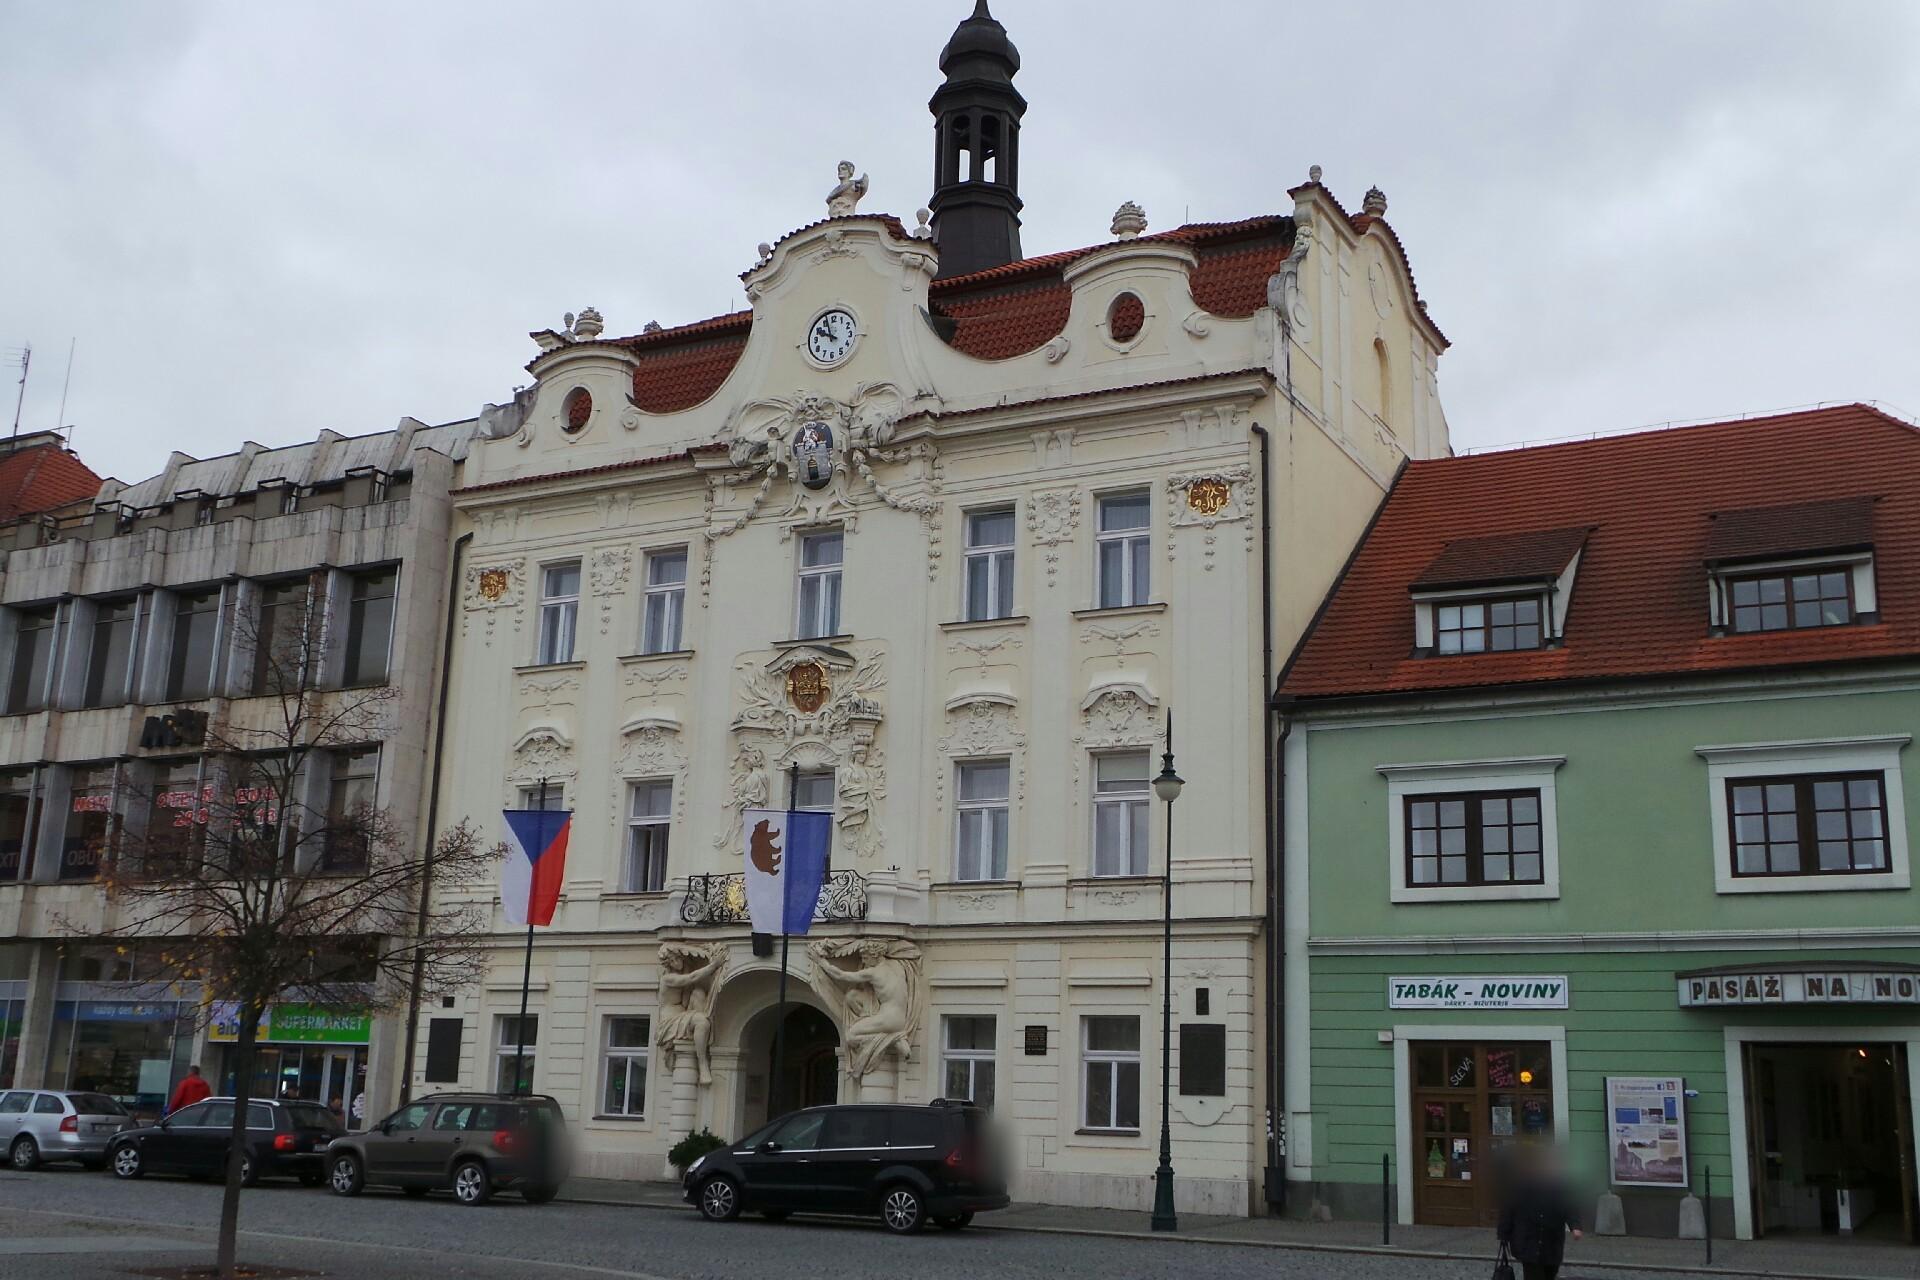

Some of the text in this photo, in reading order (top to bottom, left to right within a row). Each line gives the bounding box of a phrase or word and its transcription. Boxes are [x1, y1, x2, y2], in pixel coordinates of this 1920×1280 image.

[831, 315, 837, 323] 12
[840, 316, 843, 324] 1
[846, 321, 850, 330] 2
[815, 345, 820, 353] 8
[839, 347, 843, 356] 5
[823, 350, 827, 358] 7
[1395, 980, 1458, 999] TABÁK
[1480, 983, 1561, 999] NOVINY
[1692, 976, 1920, 1000] PASÁŽ NA NO
[1450, 1057, 1474, 1086] SLEVA
